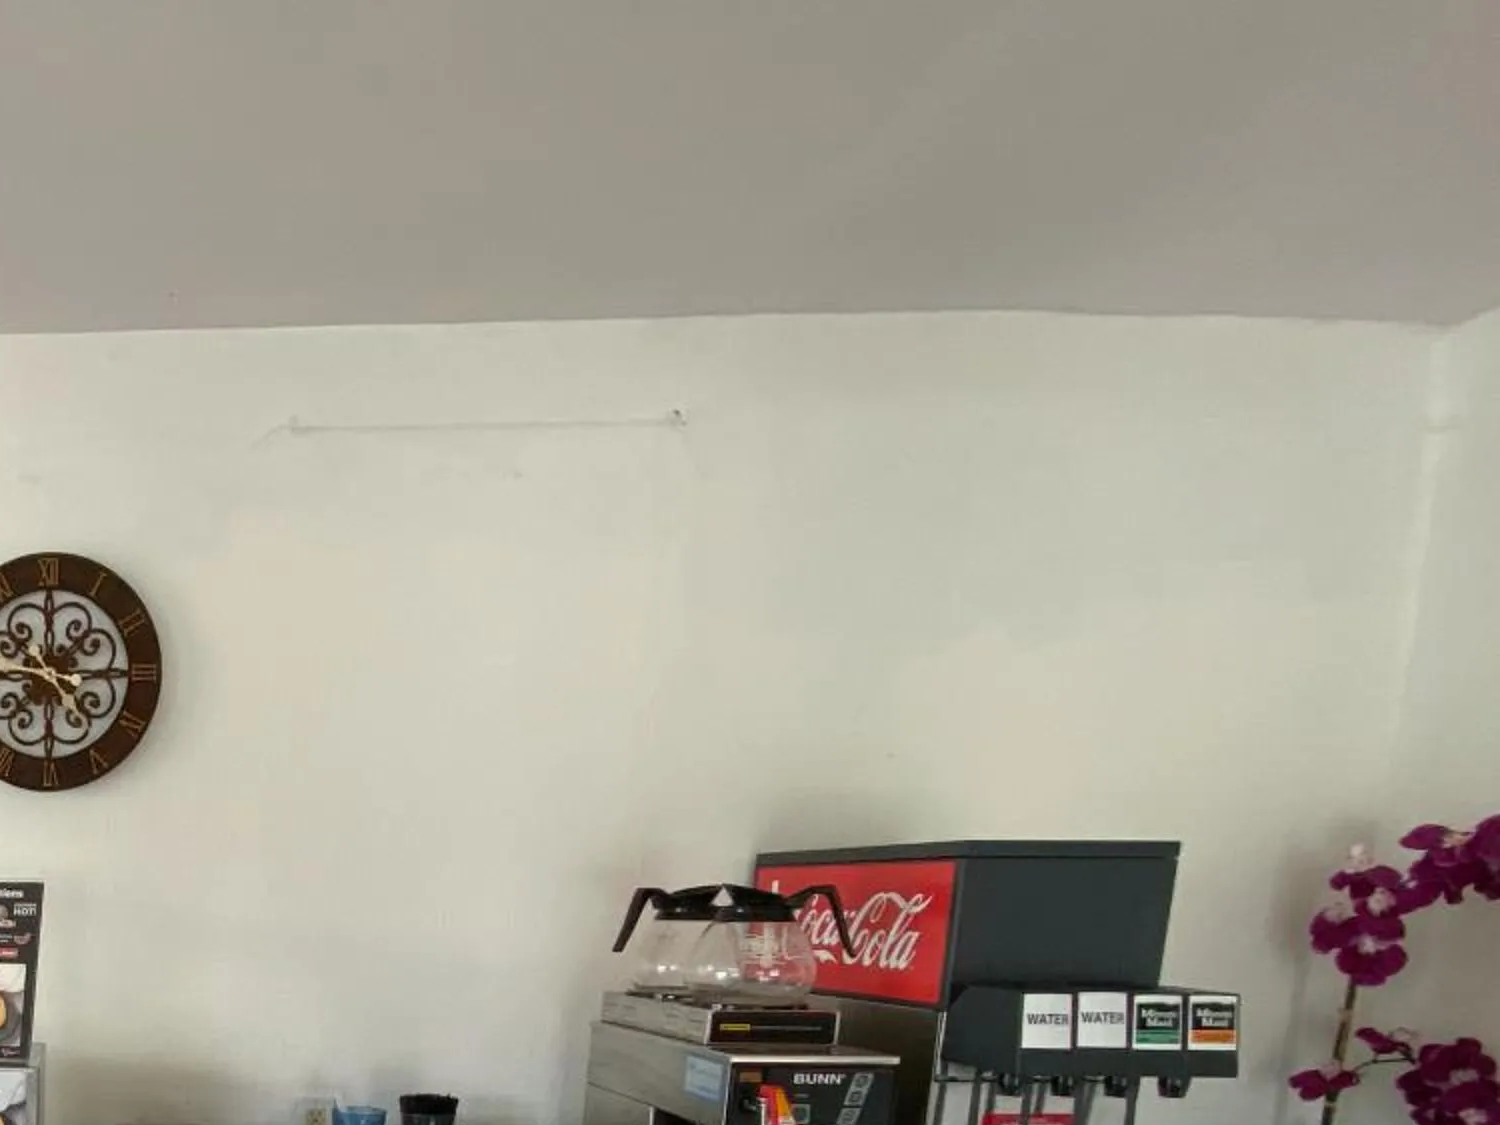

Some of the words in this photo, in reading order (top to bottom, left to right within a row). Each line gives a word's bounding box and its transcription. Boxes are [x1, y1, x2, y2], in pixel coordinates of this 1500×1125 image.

[38, 558, 59, 585] XII
[89, 573, 107, 597] I
[119, 610, 146, 637] II
[131, 663, 156, 681] III
[43, 760, 59, 787] VI
[89, 750, 109, 774] V
[1027, 1013, 1069, 1025] WATER
[1081, 1011, 1125, 1025] WATER
[793, 1073, 844, 1085] BUNN
